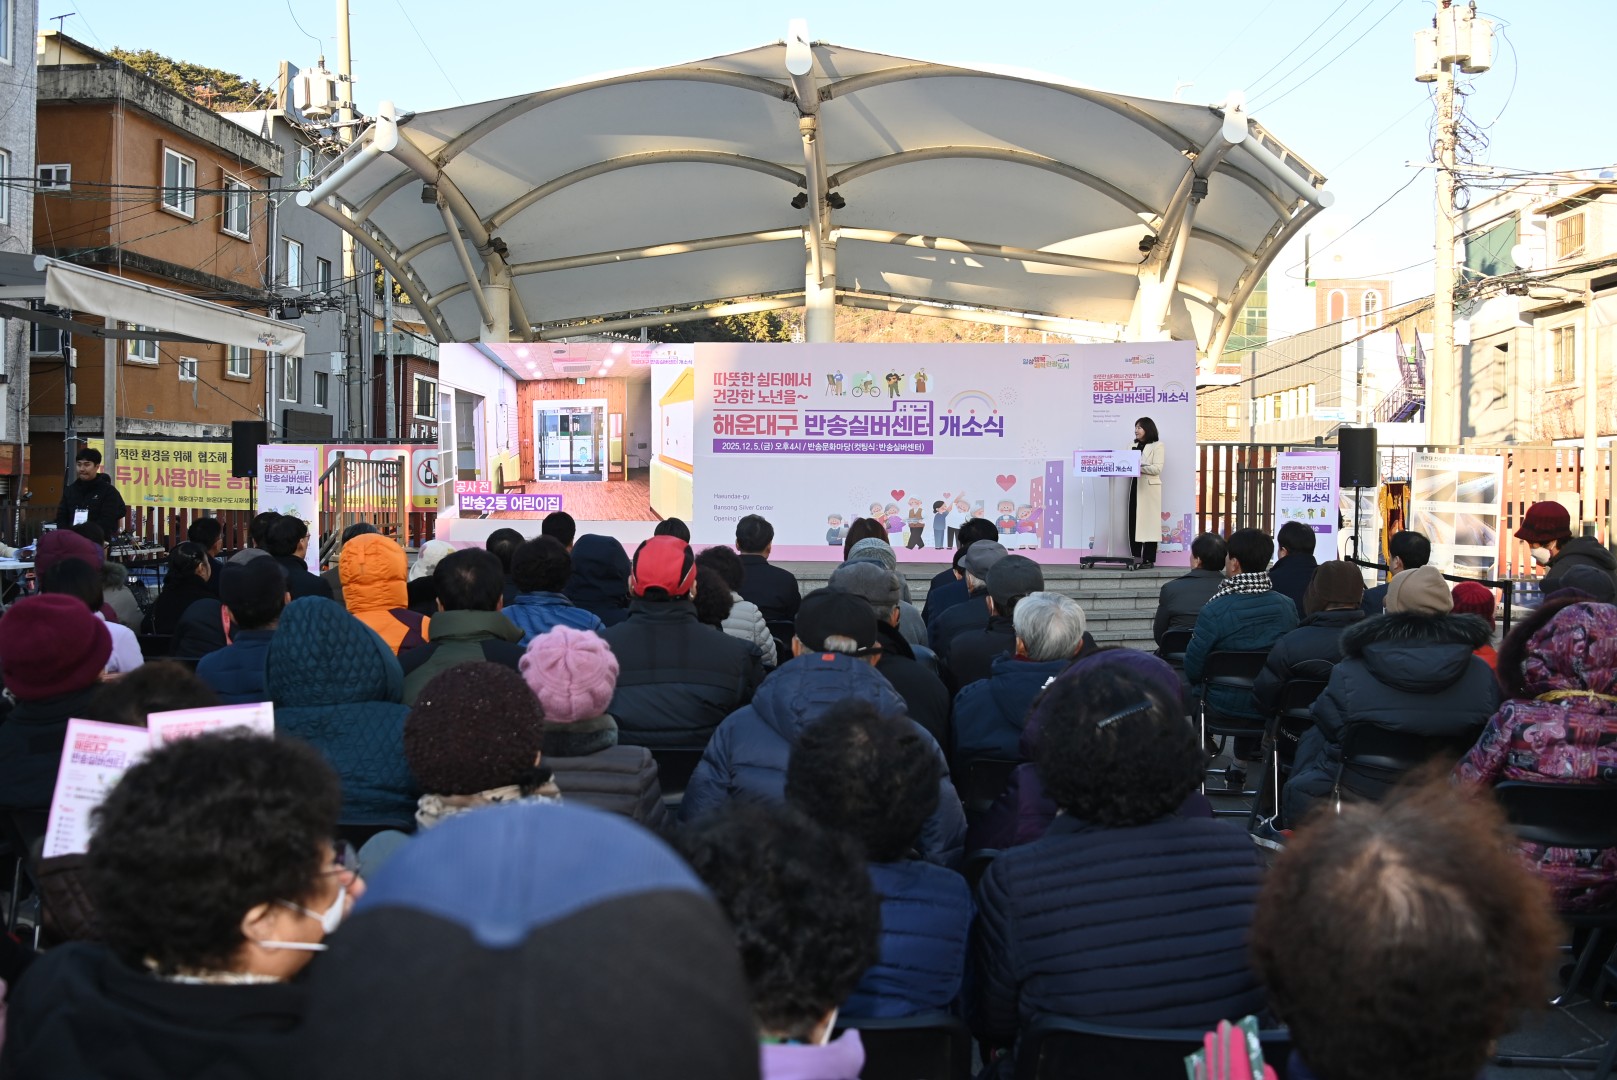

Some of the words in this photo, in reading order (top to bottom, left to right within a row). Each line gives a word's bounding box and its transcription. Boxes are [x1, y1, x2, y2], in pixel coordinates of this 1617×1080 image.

[713, 371, 756, 387] 따뜻한
[757, 371, 812, 387] 쉼터에서
[1093, 381, 1134, 392] 해운대구
[713, 389, 756, 404] 건강한
[1093, 392, 1155, 404] 반송실버센터
[1158, 392, 1189, 403] 개소식
[713, 413, 799, 437] 해운대구
[804, 413, 934, 437] 반송실버센터
[939, 415, 1004, 438] 개소식
[141, 449, 171, 462] 환경을
[173, 450, 192, 462] 위해
[197, 451, 227, 463] 협조해
[264, 464, 296, 474] 해운대구
[154, 467, 221, 489] 사용하는
[264, 473, 312, 484] 반송실버센터
[1281, 472, 1314, 482] 해운대구
[286, 485, 312, 495] 개소식
[455, 481, 477, 493] 공사
[479, 481, 490, 493] 전
[1281, 481, 1330, 491] 반송실버센터
[461, 495, 508, 510] 반송2동
[510, 496, 560, 511] 어린이집
[1302, 493, 1330, 503] 개소식
[713, 504, 738, 512] Bansong
[739, 504, 755, 512] Silver
